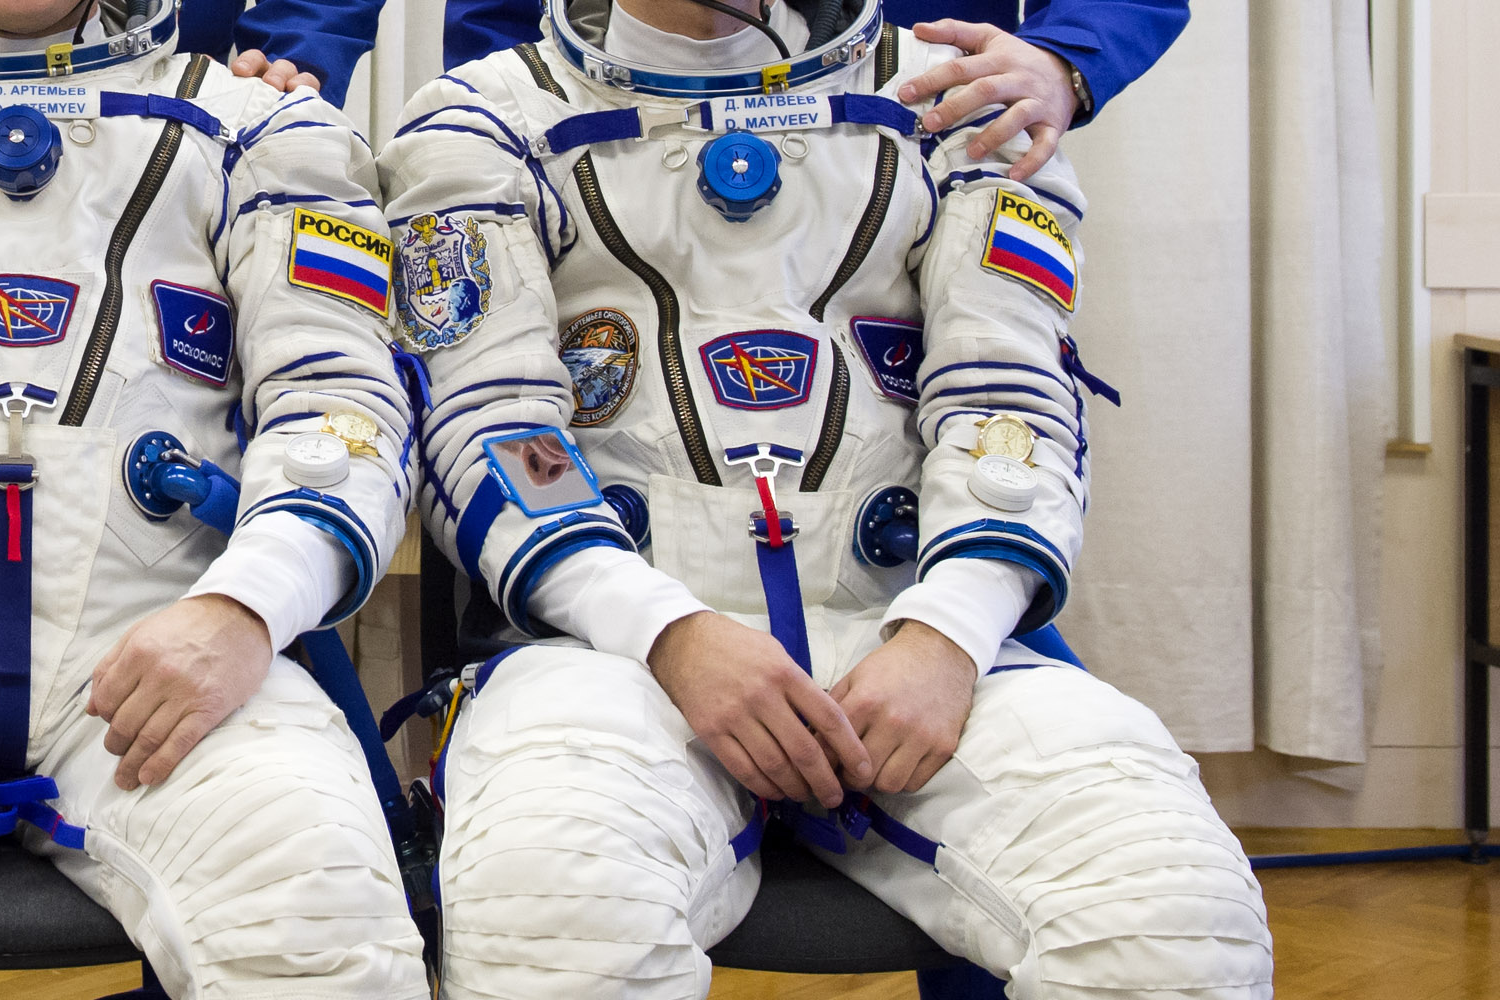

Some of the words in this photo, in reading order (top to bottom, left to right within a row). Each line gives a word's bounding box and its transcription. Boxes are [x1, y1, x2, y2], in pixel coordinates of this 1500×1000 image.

[10, 85, 86, 96] АРТЕМЬЕВ
[725, 98, 740, 112] Д.
[744, 95, 817, 109] МАТВЕЕВ
[725, 118, 740, 130] D.
[746, 113, 818, 129] MATVEEV
[299, 213, 391, 263] РОССИЯ
[441, 266, 453, 278] 21
[172, 338, 224, 368] РОСКОСМОС
